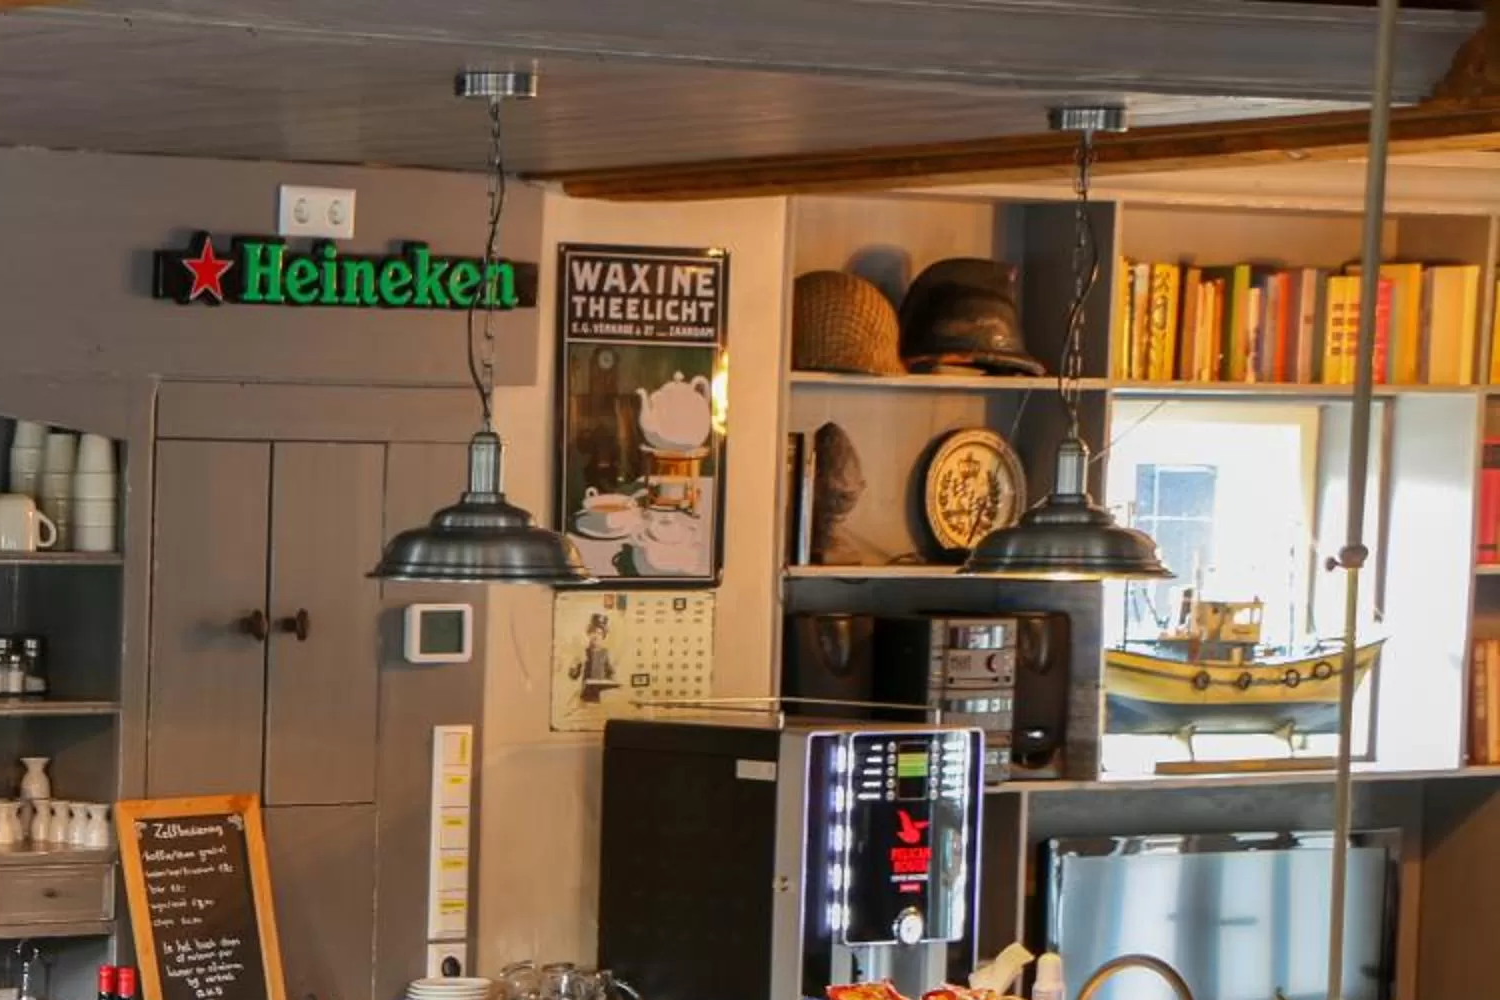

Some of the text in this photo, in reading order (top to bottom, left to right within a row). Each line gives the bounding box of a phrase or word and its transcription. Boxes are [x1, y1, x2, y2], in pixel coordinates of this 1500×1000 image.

[242, 242, 519, 306] Heineken
[571, 260, 715, 297] WAXINE
[571, 296, 715, 323] THEELICHT
